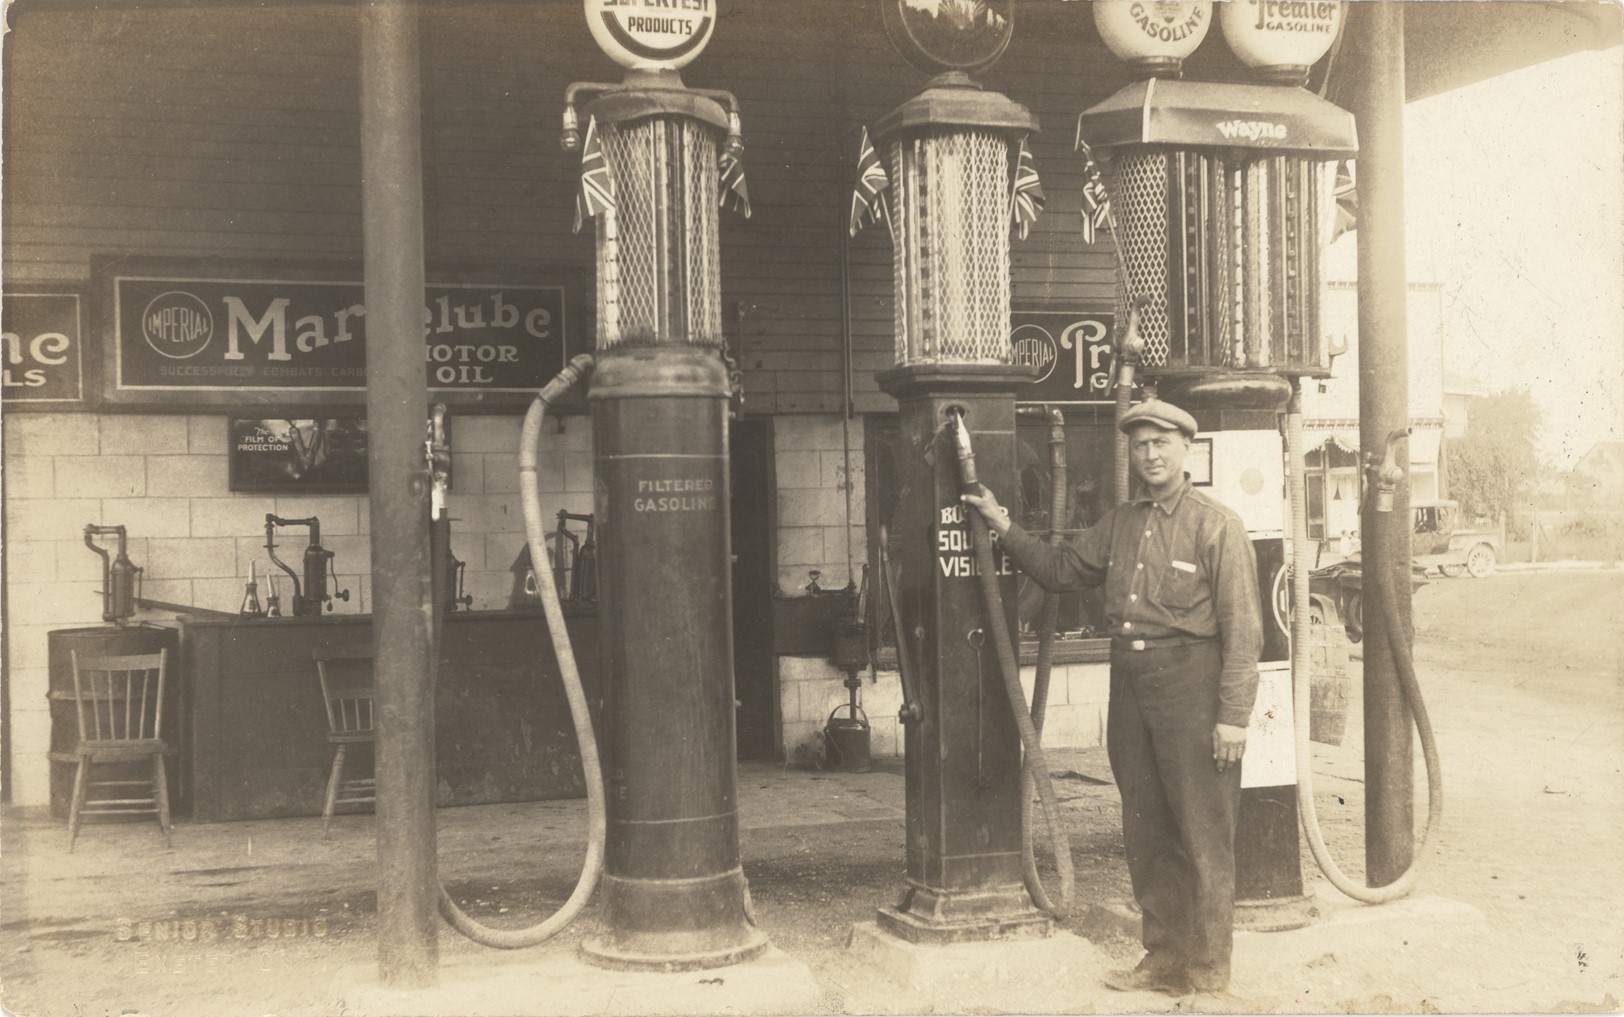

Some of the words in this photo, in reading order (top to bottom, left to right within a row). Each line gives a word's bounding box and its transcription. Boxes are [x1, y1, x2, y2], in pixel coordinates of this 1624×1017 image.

[628, 16, 692, 35] PRODUCTS
[1130, 2, 1204, 42] GASOLINE
[1266, 22, 1331, 33] GASOLINE
[1216, 119, 1287, 141] Wayne
[149, 307, 209, 343] IMPERIAL
[222, 292, 550, 361] Marlube
[1011, 338, 1054, 369] MPERIAL
[263, 366, 322, 377] COMBATS
[436, 365, 494, 383] OIL
[237, 444, 288, 452] PROTECTION
[634, 496, 716, 512] GASOLINE
[939, 556, 1013, 577] VISIE
